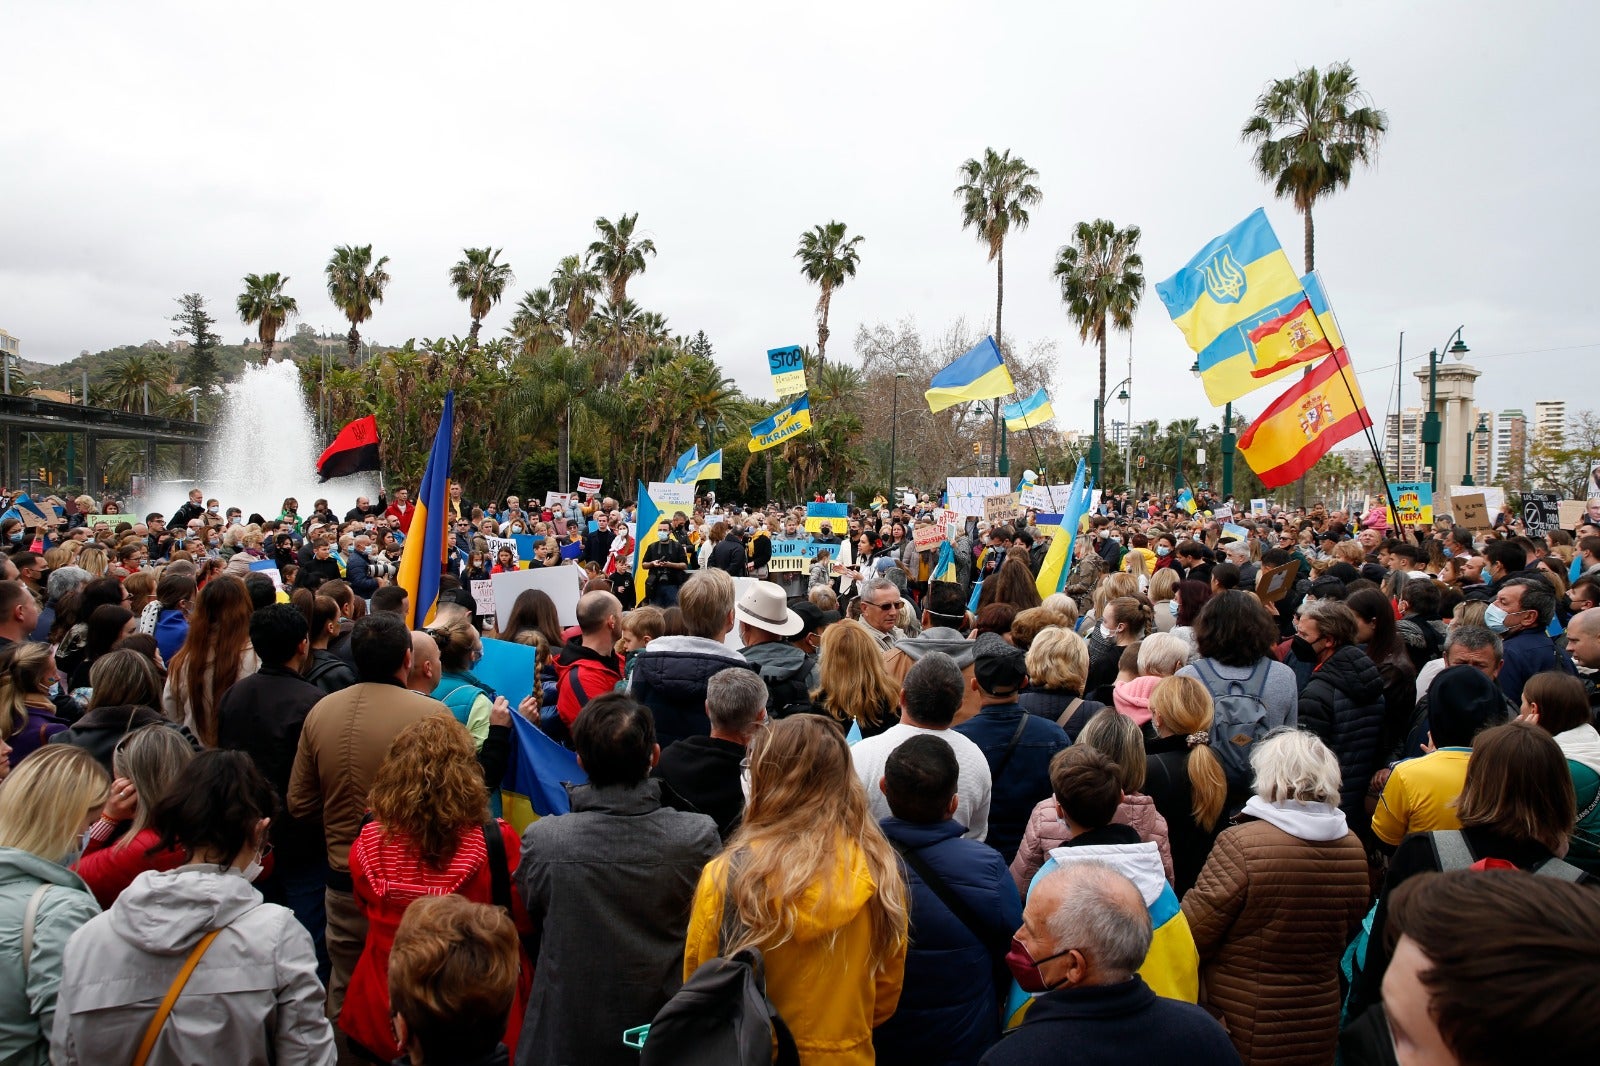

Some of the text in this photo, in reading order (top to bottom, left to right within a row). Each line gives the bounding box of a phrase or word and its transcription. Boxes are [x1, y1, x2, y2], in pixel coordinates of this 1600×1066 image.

[771, 348, 801, 369] STOP
[760, 422, 803, 446] UKRAINE
[987, 498, 1006, 508] PUTIN
[1399, 494, 1418, 502] PUTIN
[988, 509, 1018, 521] UKRAINE
[1400, 512, 1423, 522] UERRA
[772, 544, 796, 553] STOP
[809, 546, 835, 556] STP
[771, 558, 803, 570] PUTIN
